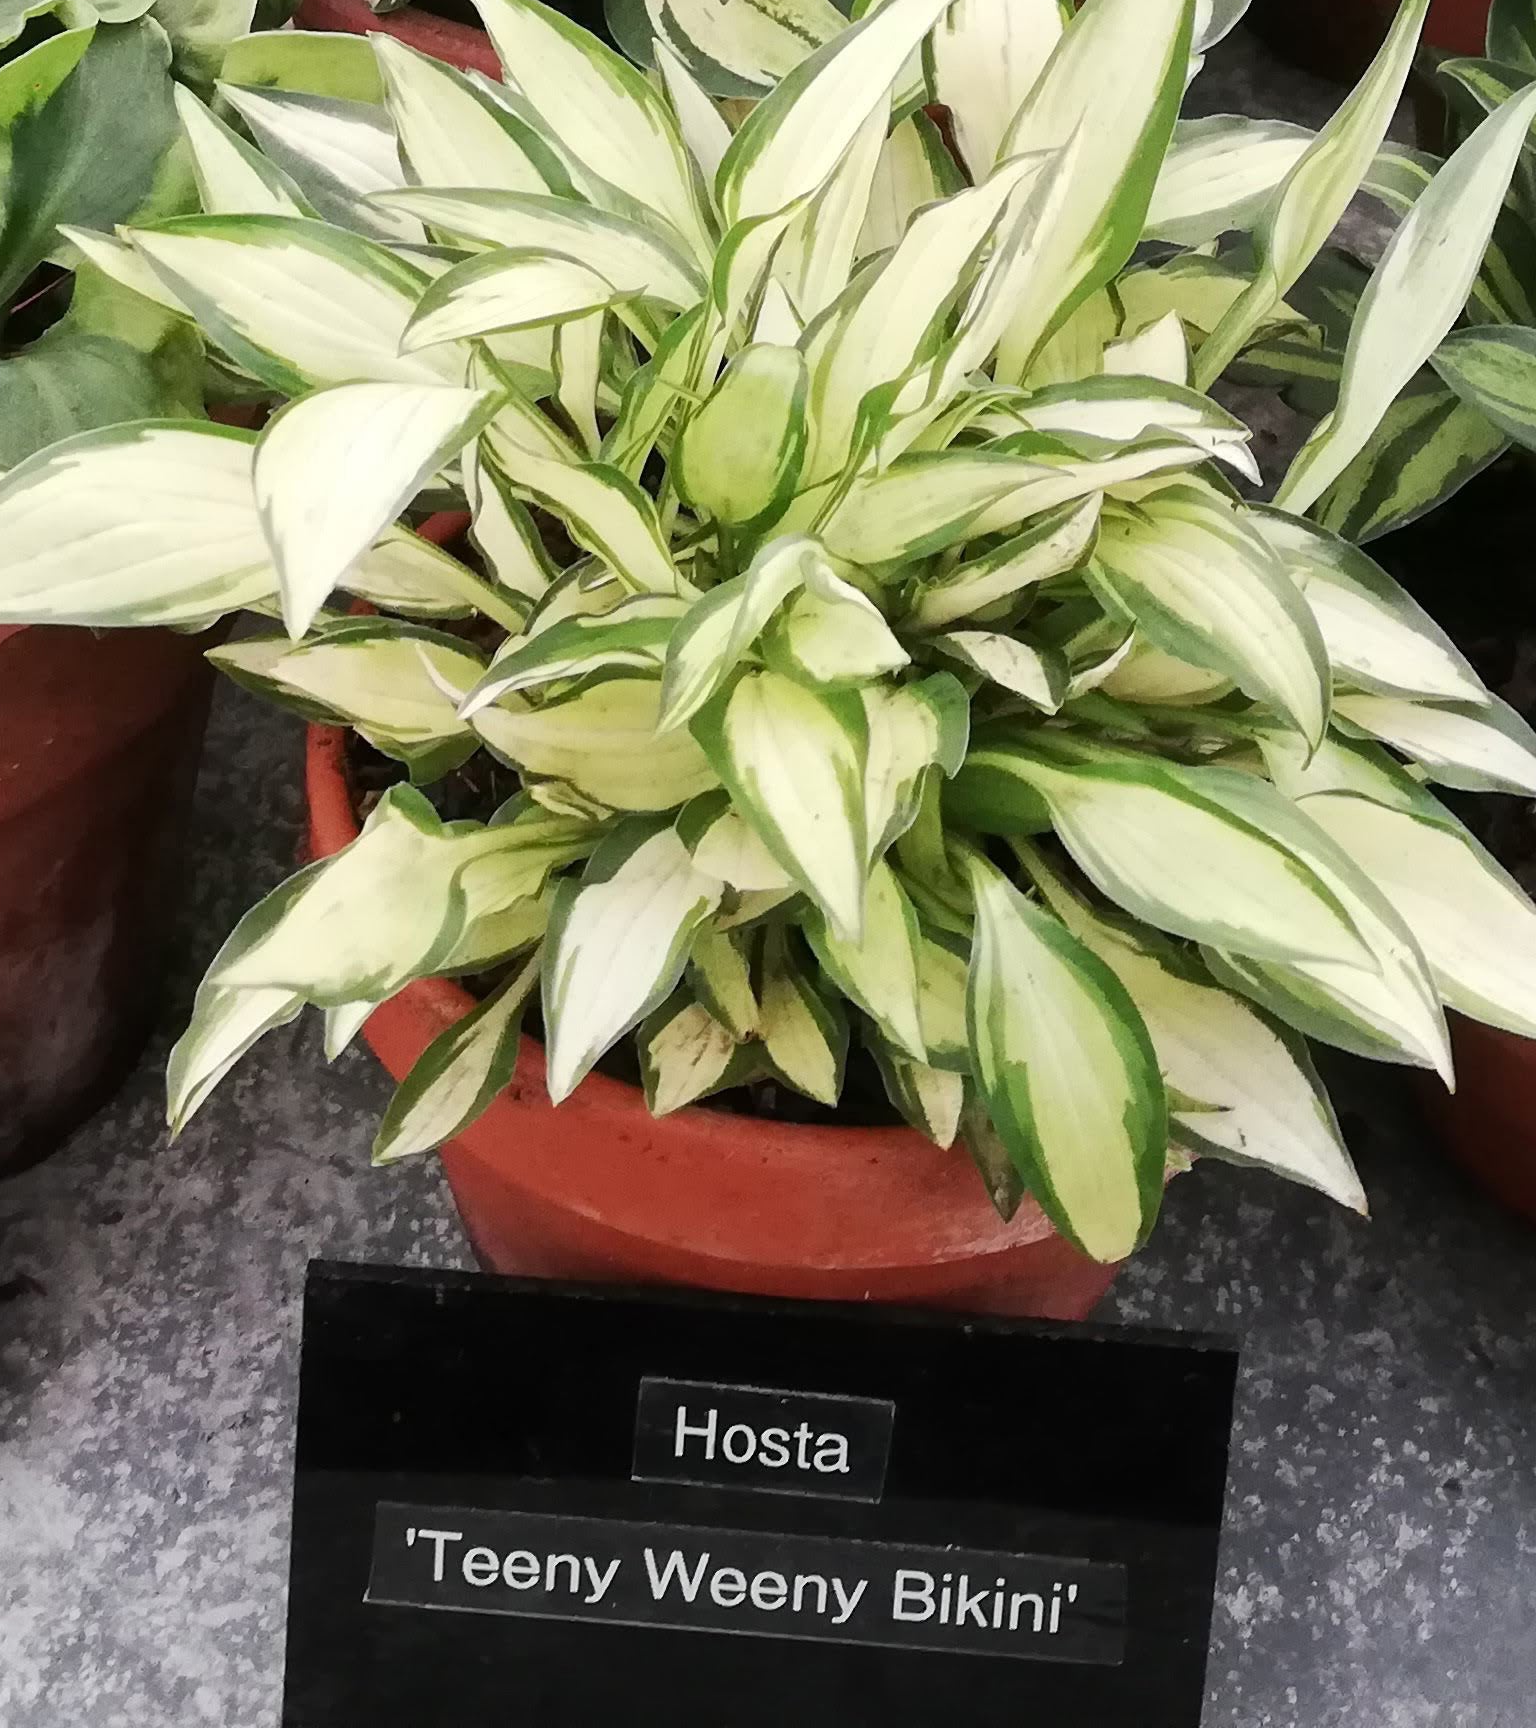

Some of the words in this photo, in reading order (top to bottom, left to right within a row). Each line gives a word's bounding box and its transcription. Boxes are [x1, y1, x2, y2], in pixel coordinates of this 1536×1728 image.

[673, 1405, 851, 1475] Hosta
[404, 1525, 622, 1604] 'Teeny
[643, 1546, 870, 1626] Weeny
[892, 1568, 1080, 1635] Bikini'
